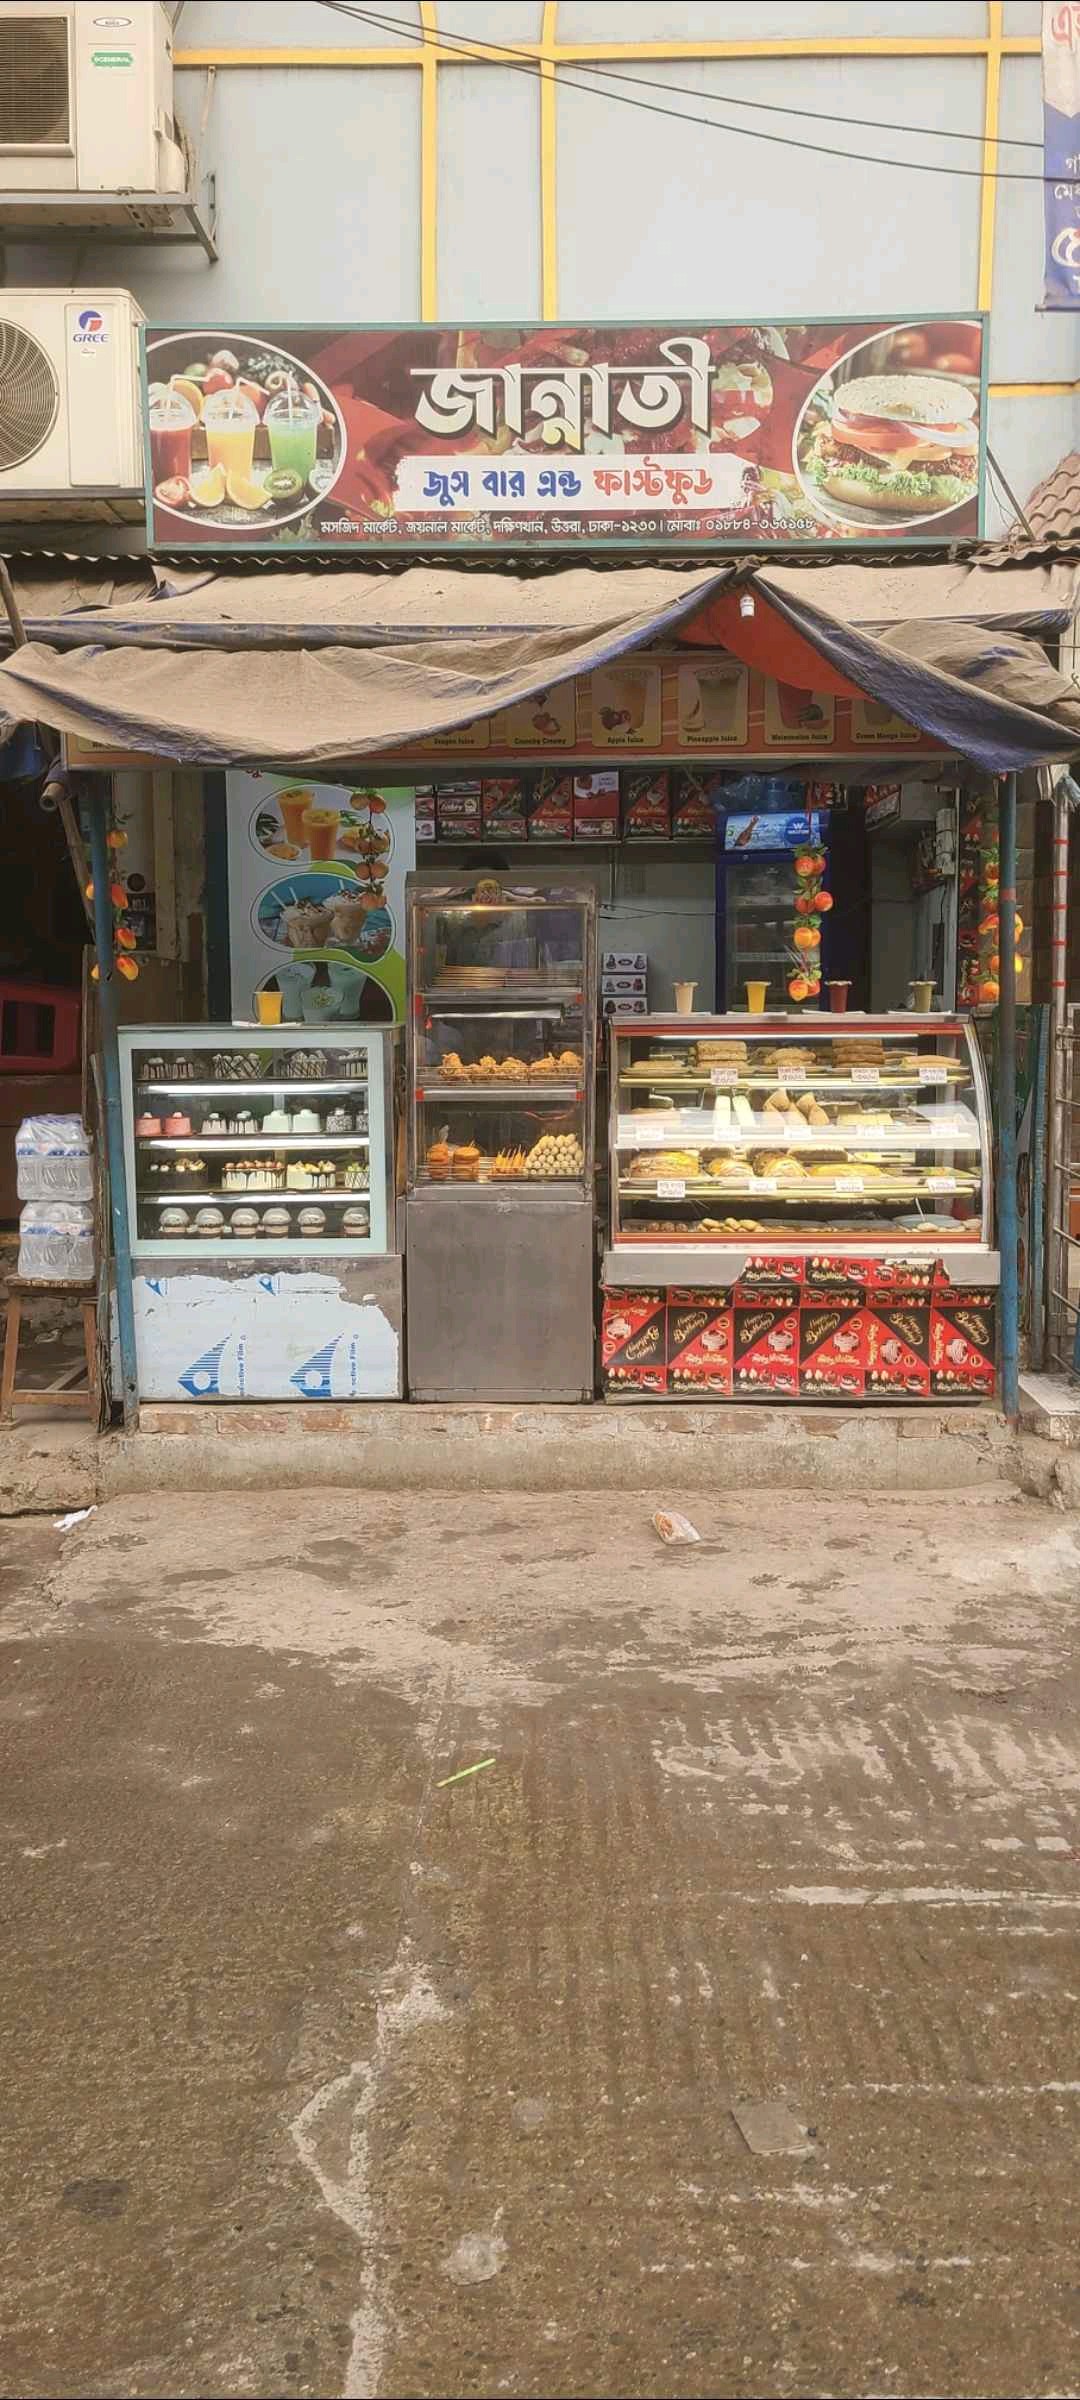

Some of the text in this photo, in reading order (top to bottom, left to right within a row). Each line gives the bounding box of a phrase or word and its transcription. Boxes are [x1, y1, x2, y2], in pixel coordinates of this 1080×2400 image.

[73, 333, 110, 343] GREE
[410, 336, 716, 452] জান্নাতী
[422, 455, 714, 507] জুস বার এন্ড ফাস্টফুড
[320, 517, 360, 534] মসজিদ
[588, 519, 657, 533] ঢাকা-১২৩০
